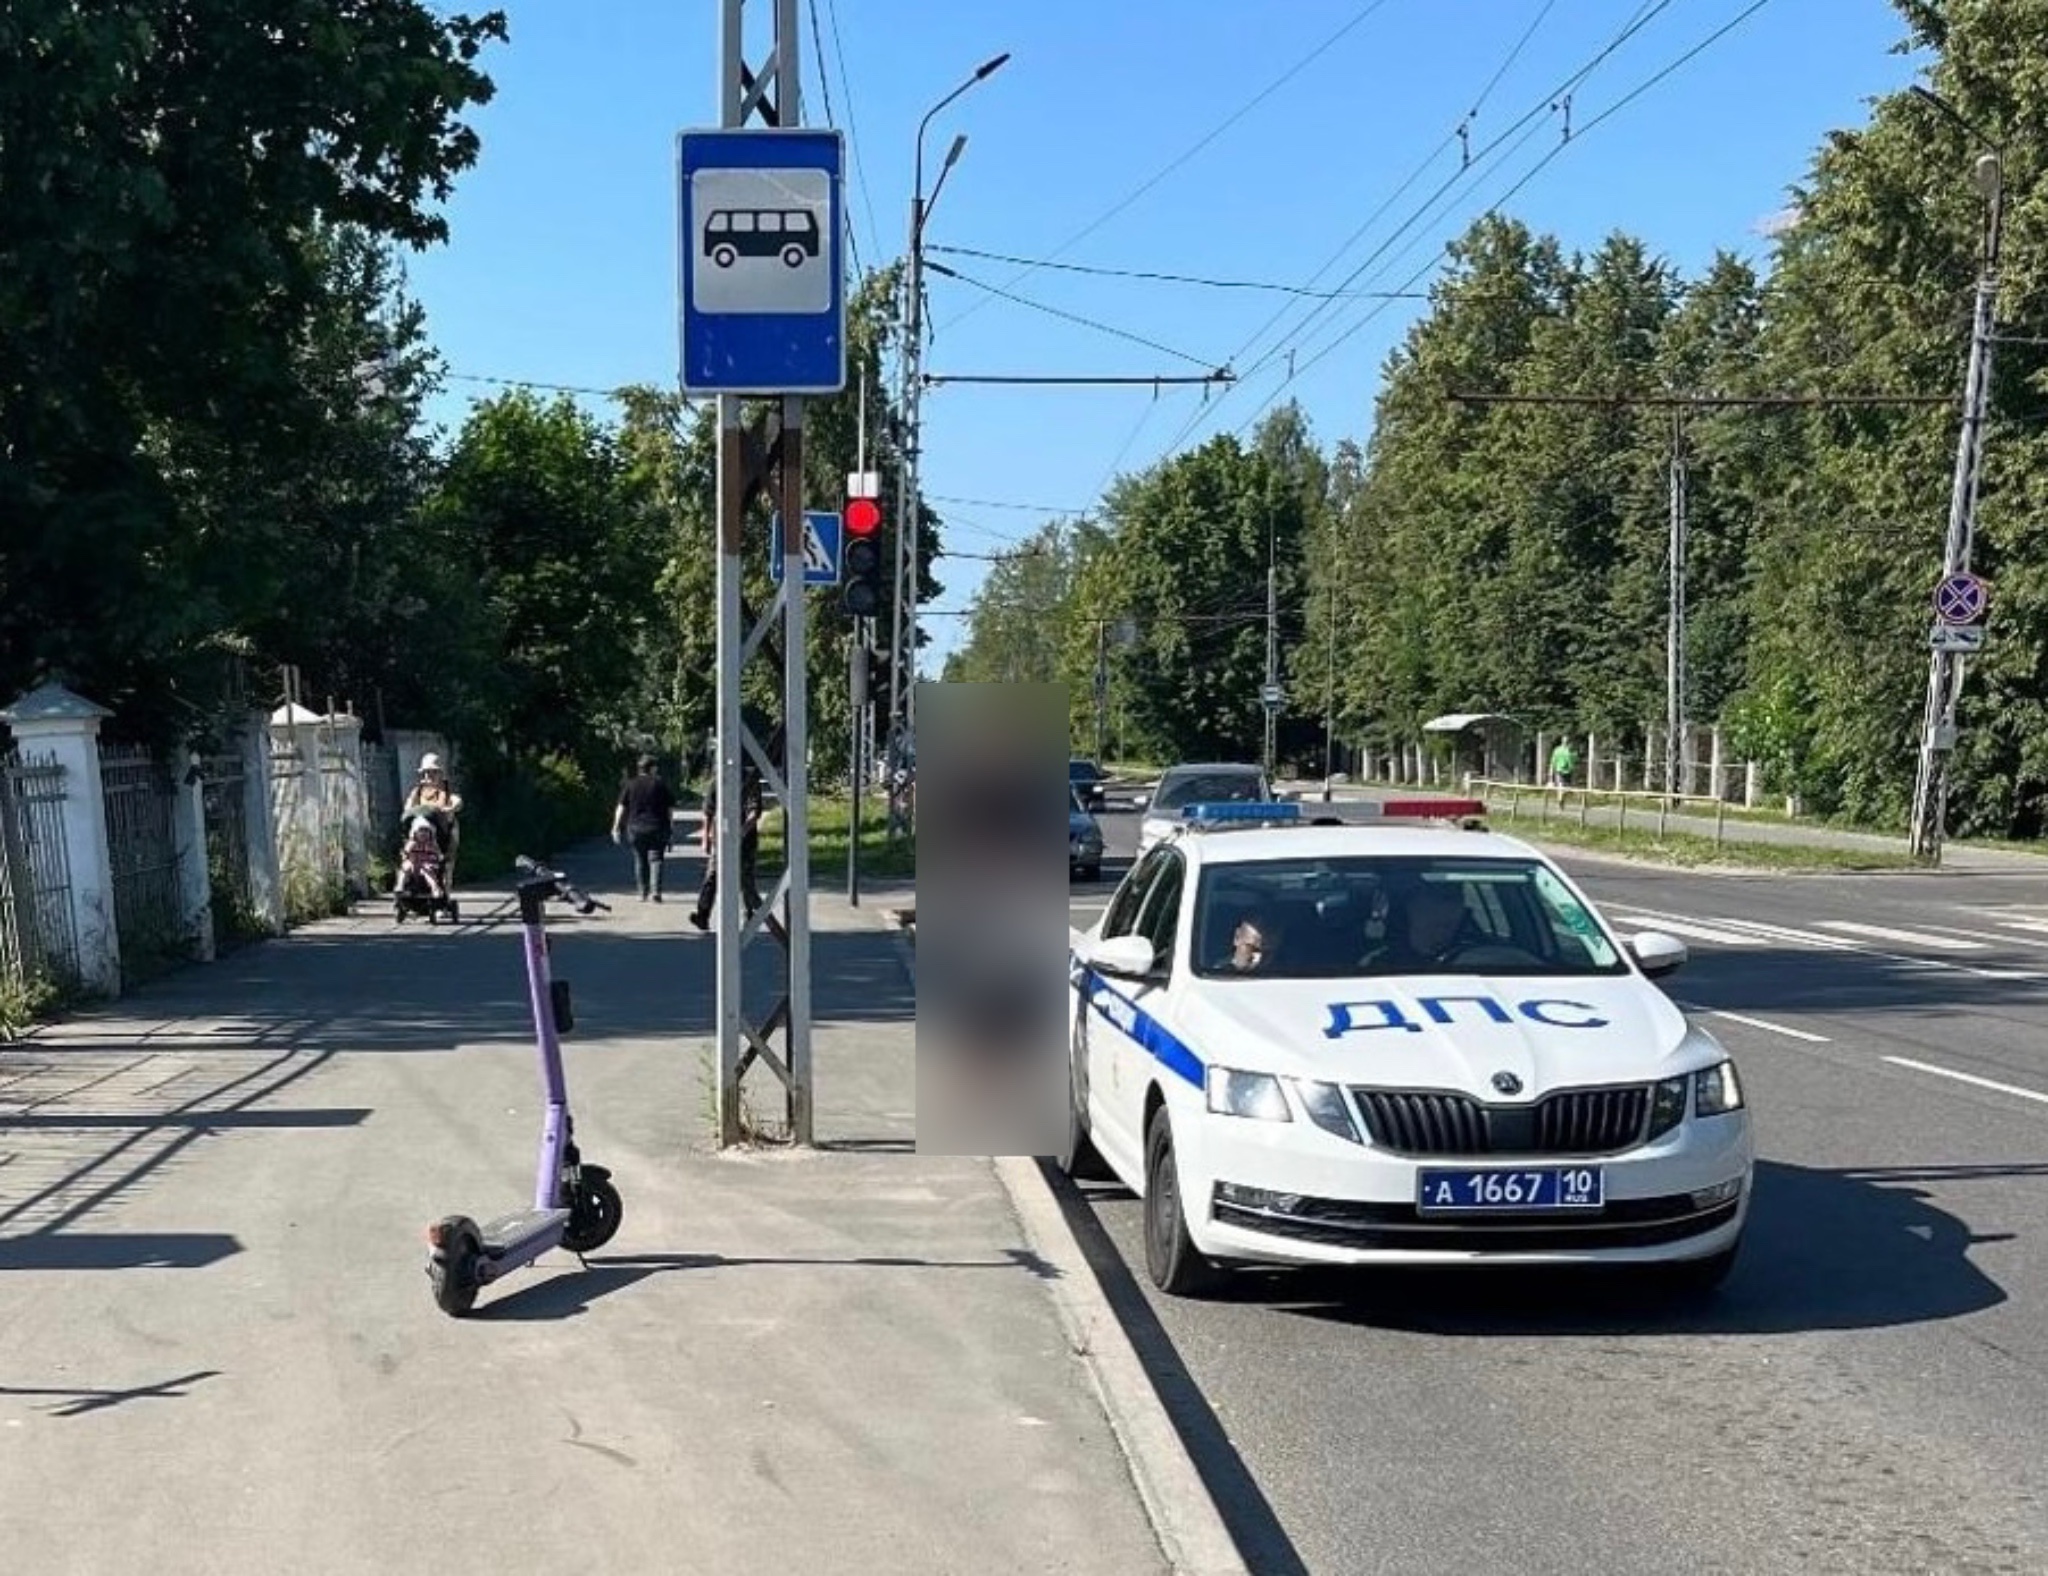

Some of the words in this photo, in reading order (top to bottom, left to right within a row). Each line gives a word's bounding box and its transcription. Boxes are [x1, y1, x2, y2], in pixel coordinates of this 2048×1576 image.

[1322, 996, 1610, 1039] ДПС
[1436, 1181, 1453, 1203] А
[1468, 1174, 1543, 1203] 1667
[1563, 1170, 1592, 1194] 10
